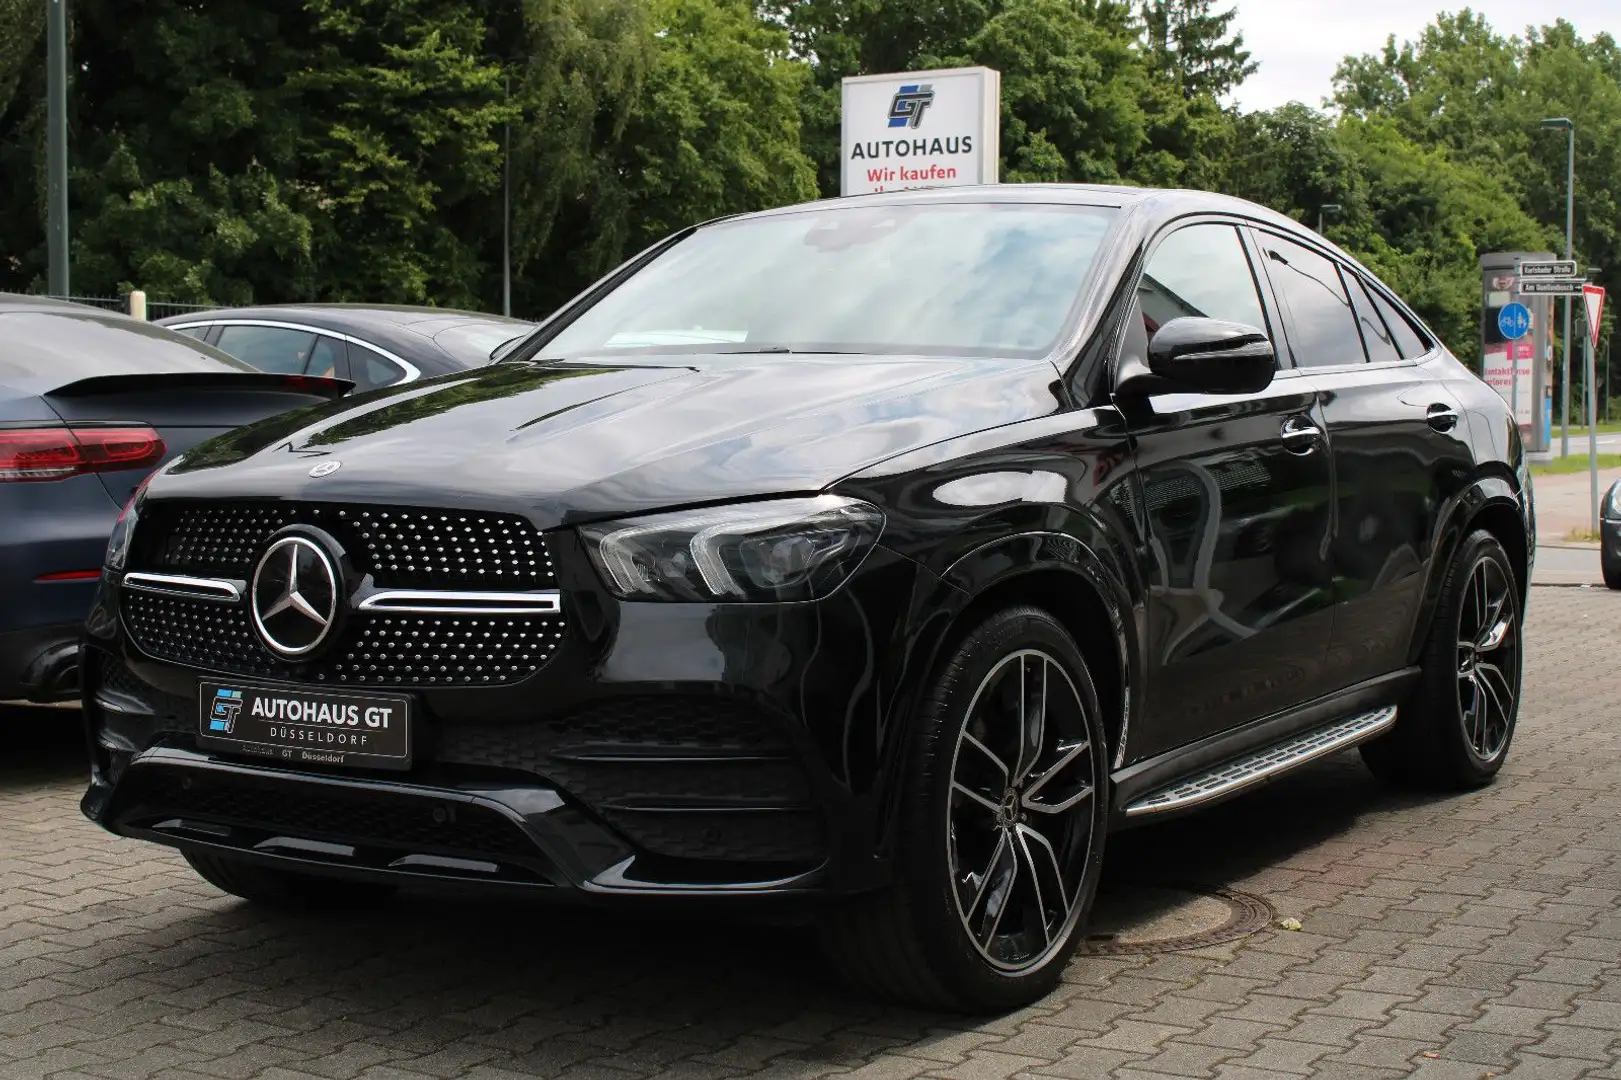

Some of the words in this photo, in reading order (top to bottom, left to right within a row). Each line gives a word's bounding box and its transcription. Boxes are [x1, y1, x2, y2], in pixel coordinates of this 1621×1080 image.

[851, 136, 972, 159] AUTOHAUS
[867, 167, 895, 182] Wir
[900, 164, 957, 181] kaufen
[251, 697, 359, 727] AUTOHAUS
[364, 707, 393, 728] GT
[270, 726, 369, 745] DÜSSELDORF
[281, 749, 293, 759] GT
[301, 751, 345, 764] Düsseldorf
